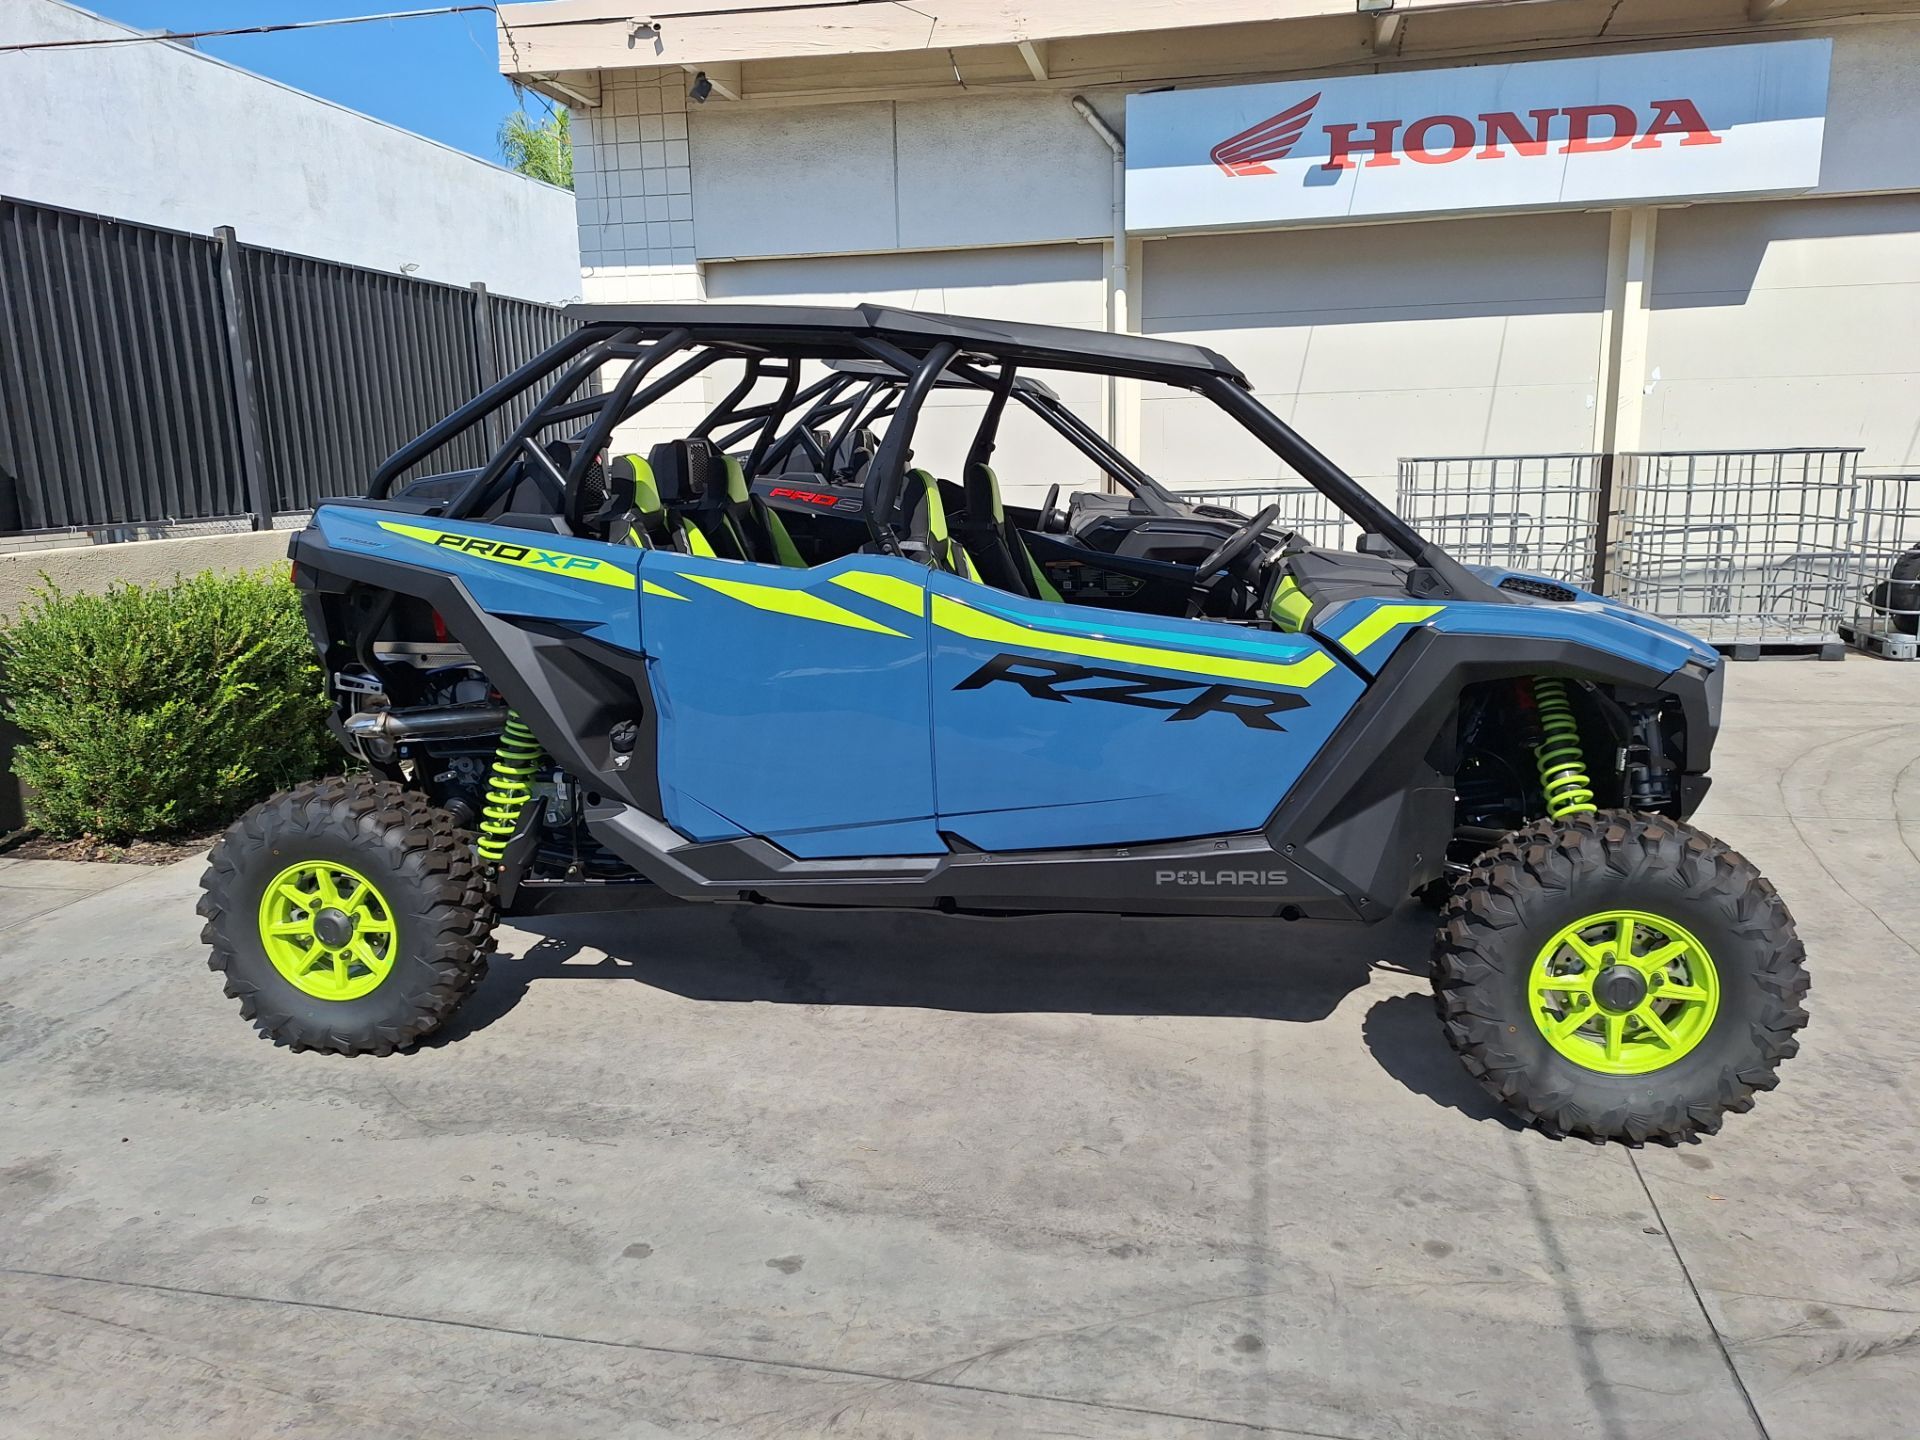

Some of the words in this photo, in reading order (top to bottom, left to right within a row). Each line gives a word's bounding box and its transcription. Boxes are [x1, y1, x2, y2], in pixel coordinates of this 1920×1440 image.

[1322, 98, 1722, 171] HONDA
[952, 653, 1311, 732] RZR
[1155, 870, 1289, 885] POLARIS
